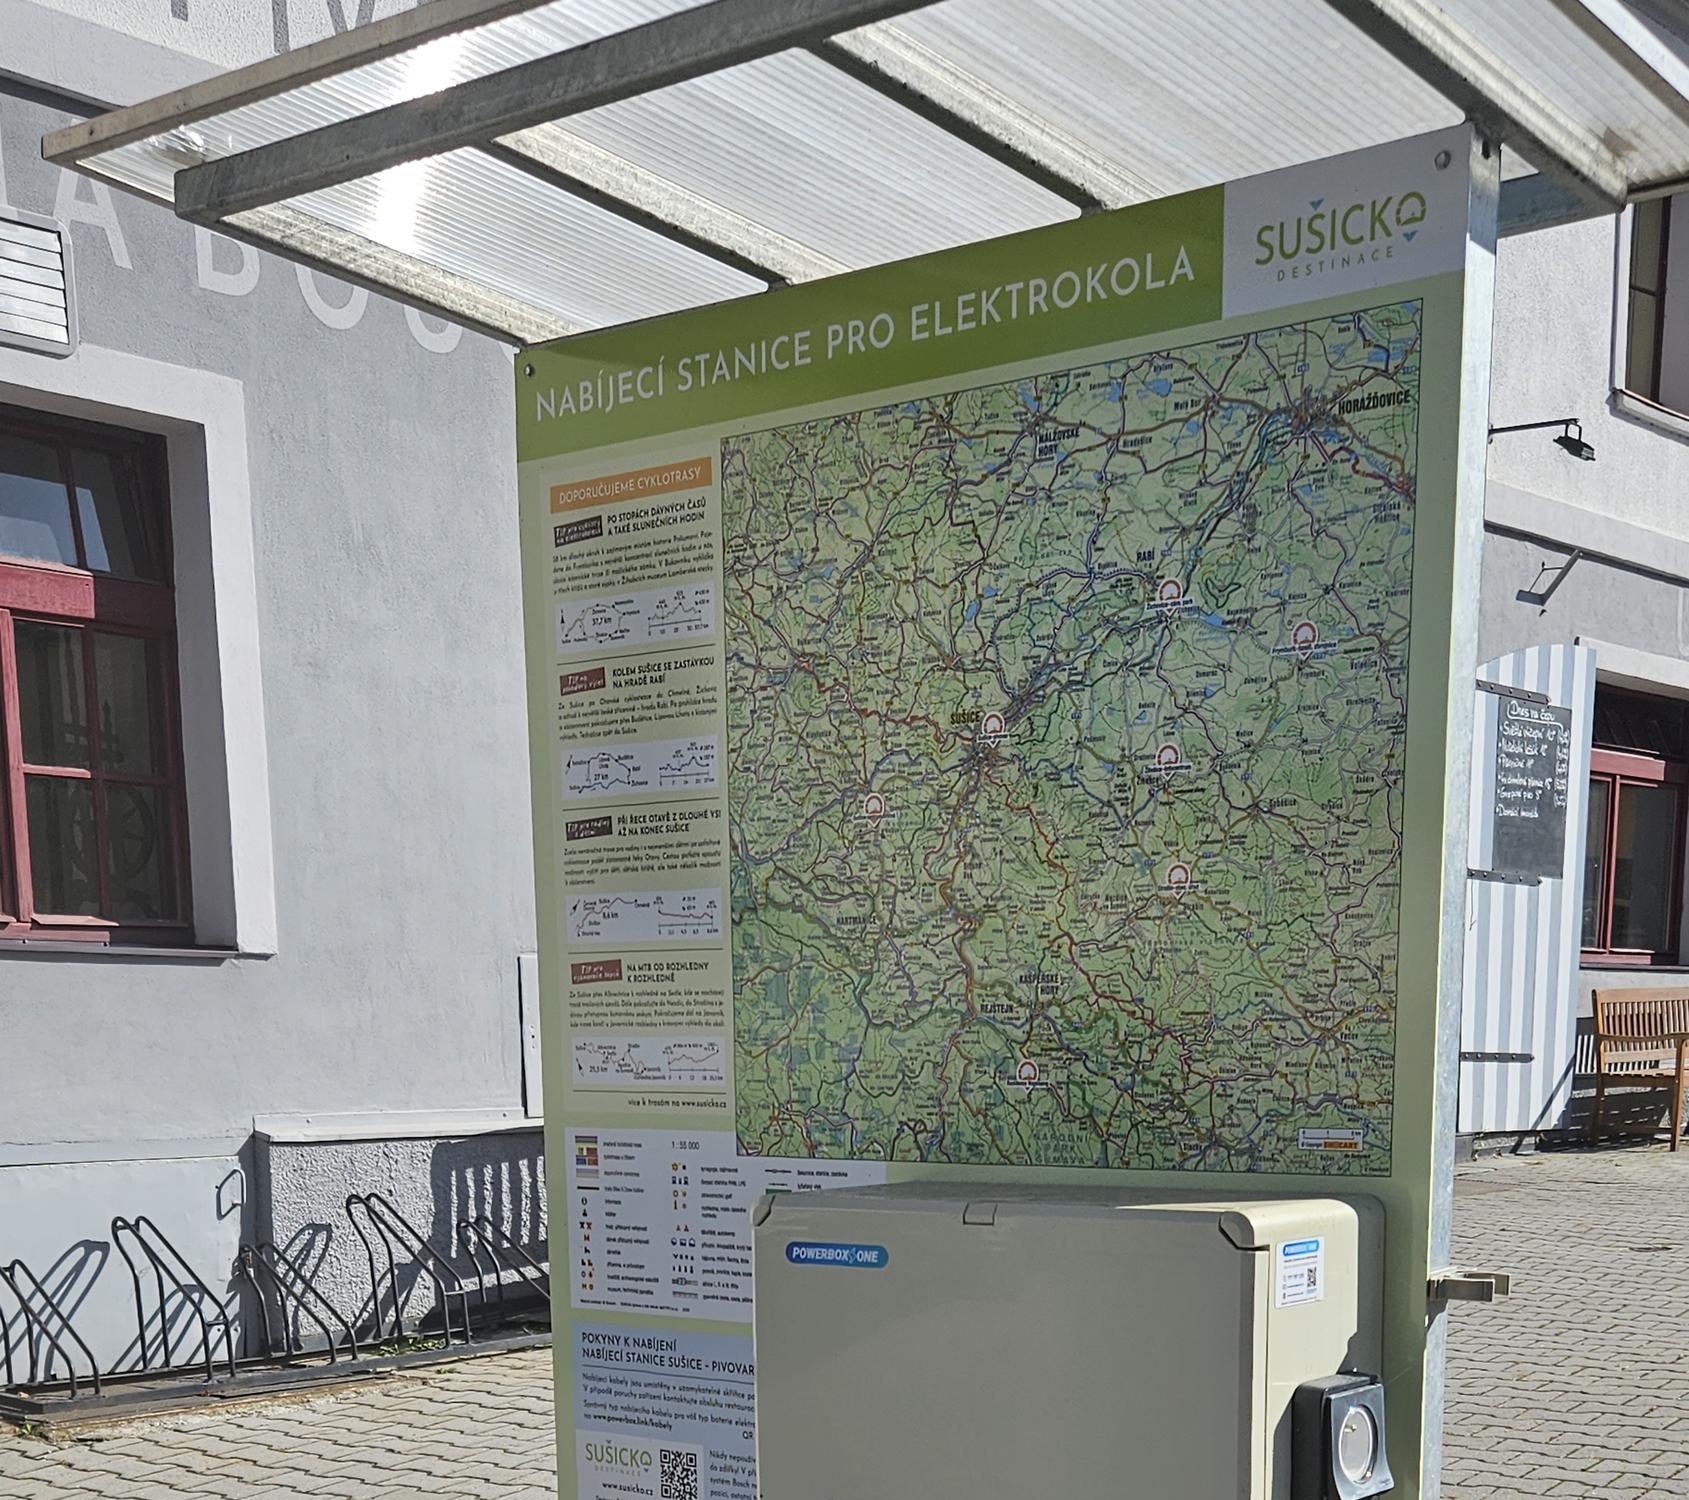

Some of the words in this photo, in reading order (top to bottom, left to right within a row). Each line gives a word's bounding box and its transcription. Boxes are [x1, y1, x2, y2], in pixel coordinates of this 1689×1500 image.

[1255, 191, 1426, 265] SUŠICKO
[1277, 246, 1393, 282] DESTINACE
[536, 355, 666, 422] NABÍJECÍ
[677, 331, 811, 391] STANICE
[827, 312, 895, 358] PRO
[911, 245, 1195, 341] ELEKTROKOLA
[1338, 390, 1410, 415] HORAŽĎOVICE
[559, 480, 634, 504] DOPORUČUJEME
[637, 467, 701, 489] CYKLOTRASY
[607, 514, 617, 523] PO
[618, 508, 648, 523] STOPÁCH
[650, 501, 685, 516] DÁVNÝCH
[687, 496, 706, 509] ČASŮ
[614, 524, 631, 536] TAKÉ
[632, 515, 678, 532] SLUNEČNÍCH
[680, 511, 705, 522] HODIN
[612, 664, 636, 677] KOLEM
[638, 662, 662, 674] SUŠICE
[664, 661, 672, 671] SE
[674, 656, 715, 670] ZASTÁVKOU
[613, 679, 622, 689] NA
[624, 674, 648, 687] HRADĚ
[649, 674, 666, 685] RABÍ
[950, 709, 981, 724] SUŠICE
[617, 815, 627, 825] PŘI
[630, 813, 646, 824] ŘECE
[649, 812, 671, 823] OTAVĚ
[679, 809, 707, 820] DLOUHÉ
[710, 810, 721, 818] VSI
[618, 826, 626, 836] AŽ
[629, 827, 638, 835] NA
[640, 824, 664, 835] KONEC
[666, 822, 689, 833] SUŠICE
[627, 963, 636, 972] NA
[654, 963, 664, 971] OD
[666, 961, 710, 970] ROZHLEDNY
[627, 975, 632, 983] K
[634, 973, 675, 983] ROZHLEDNĚ
[682, 1100, 727, 1108] www.susicko.cz
[792, 1246, 849, 1261] POWERBOX
[856, 1250, 879, 1263] ONE
[581, 1332, 621, 1346] POKYNY
[624, 1337, 630, 1347] K
[633, 1336, 677, 1352] NABÍJENÍ
[582, 1347, 623, 1362] NABÍJECÍ
[626, 1352, 665, 1367] STANICE
[668, 1356, 702, 1370] SUŠICE
[585, 1440, 652, 1468] SUŠICKO
[602, 1481, 654, 1496] www.susicko.cz
